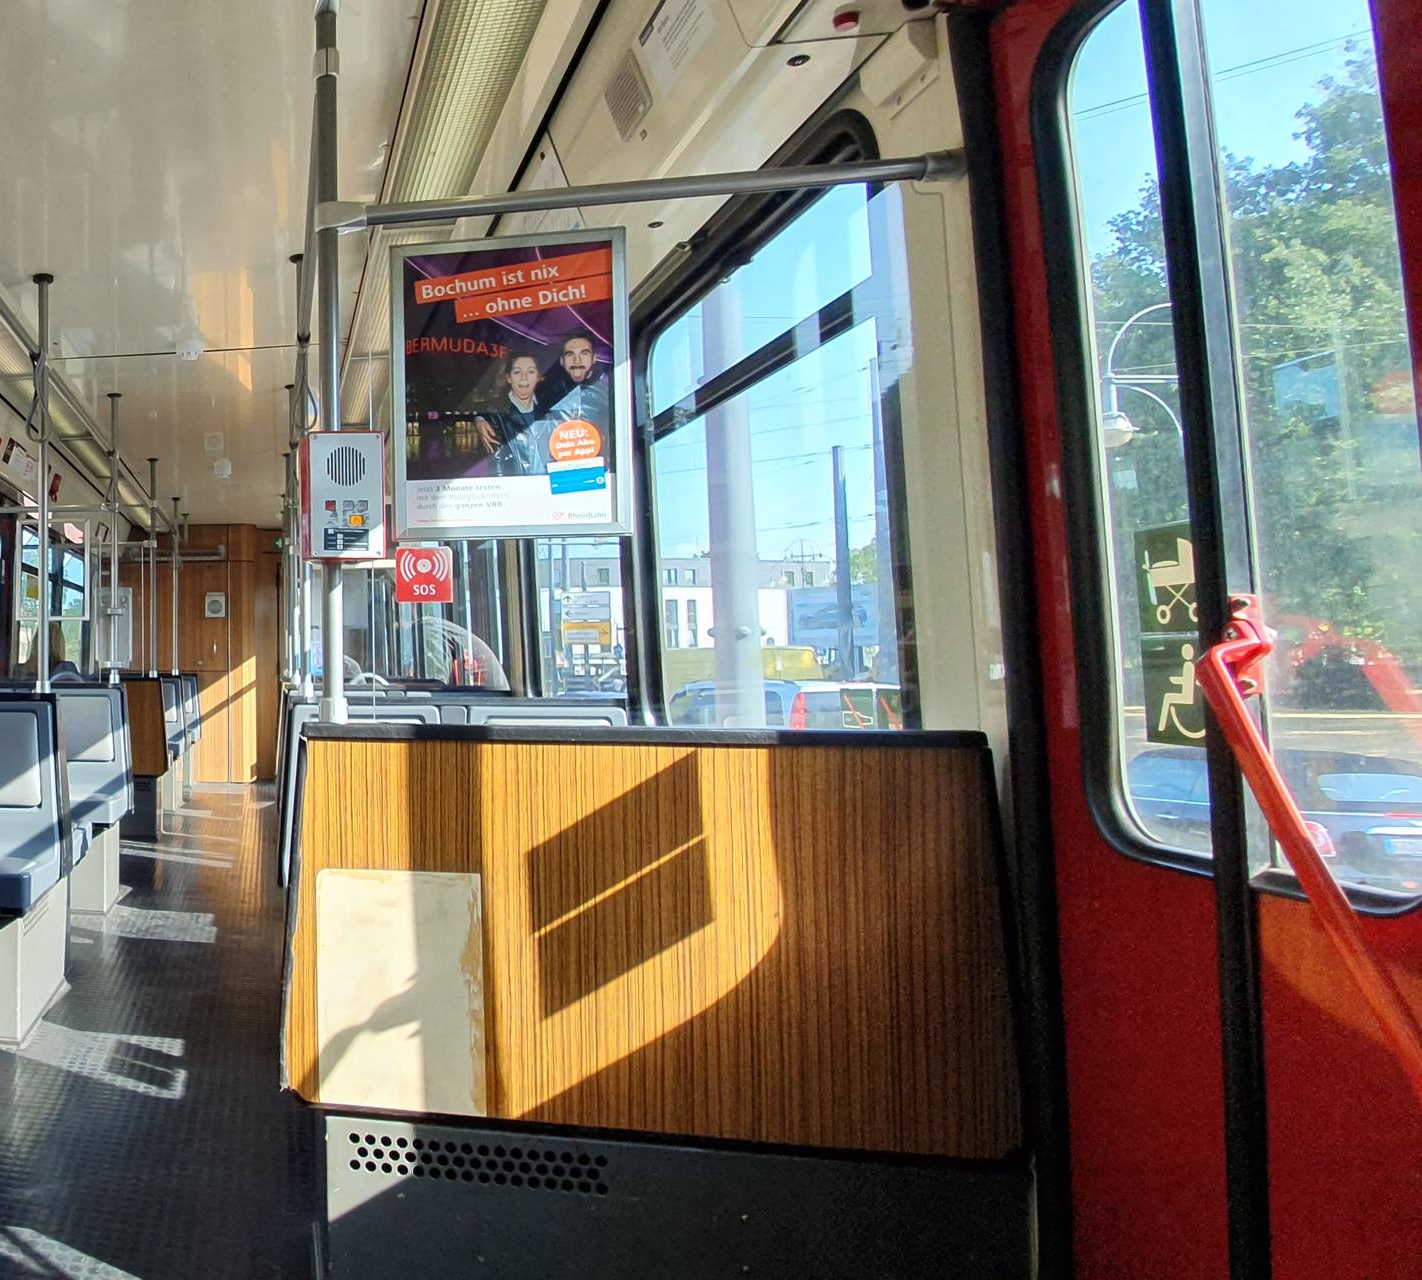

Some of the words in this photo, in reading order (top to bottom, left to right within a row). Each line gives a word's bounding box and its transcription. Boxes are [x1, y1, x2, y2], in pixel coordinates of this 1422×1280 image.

[421, 276, 496, 299] Bochum
[502, 270, 524, 286] ist
[530, 264, 560, 281] nix
[485, 297, 533, 314] ohne
[538, 284, 587, 305] Dich!
[559, 428, 589, 440] NEU:
[413, 584, 436, 596] SOS
